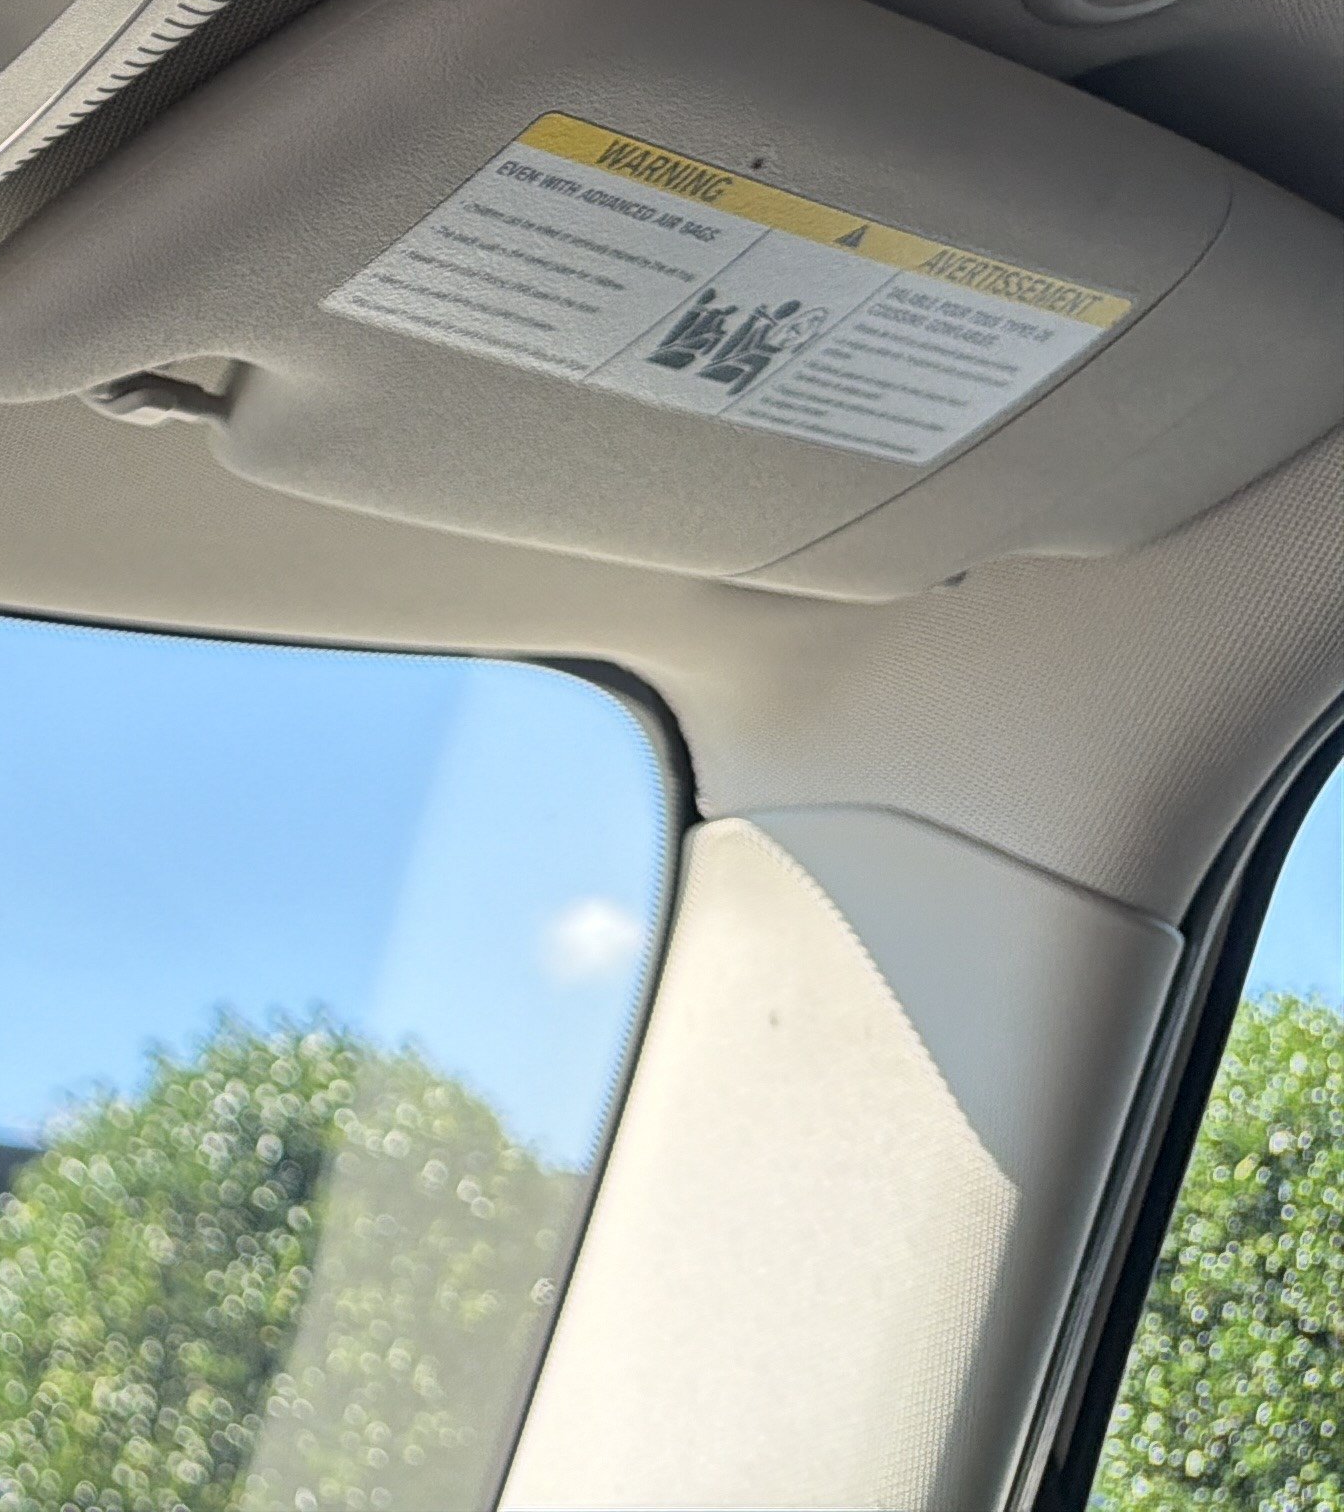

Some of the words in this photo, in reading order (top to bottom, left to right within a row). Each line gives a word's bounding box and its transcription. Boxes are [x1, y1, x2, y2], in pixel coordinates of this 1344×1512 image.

[496, 160, 543, 183] EVEN
[539, 175, 582, 196] WITH
[653, 213, 684, 230] AIR
[596, 140, 734, 202] WARNING
[917, 249, 1103, 316] AVERTISSEMENT
